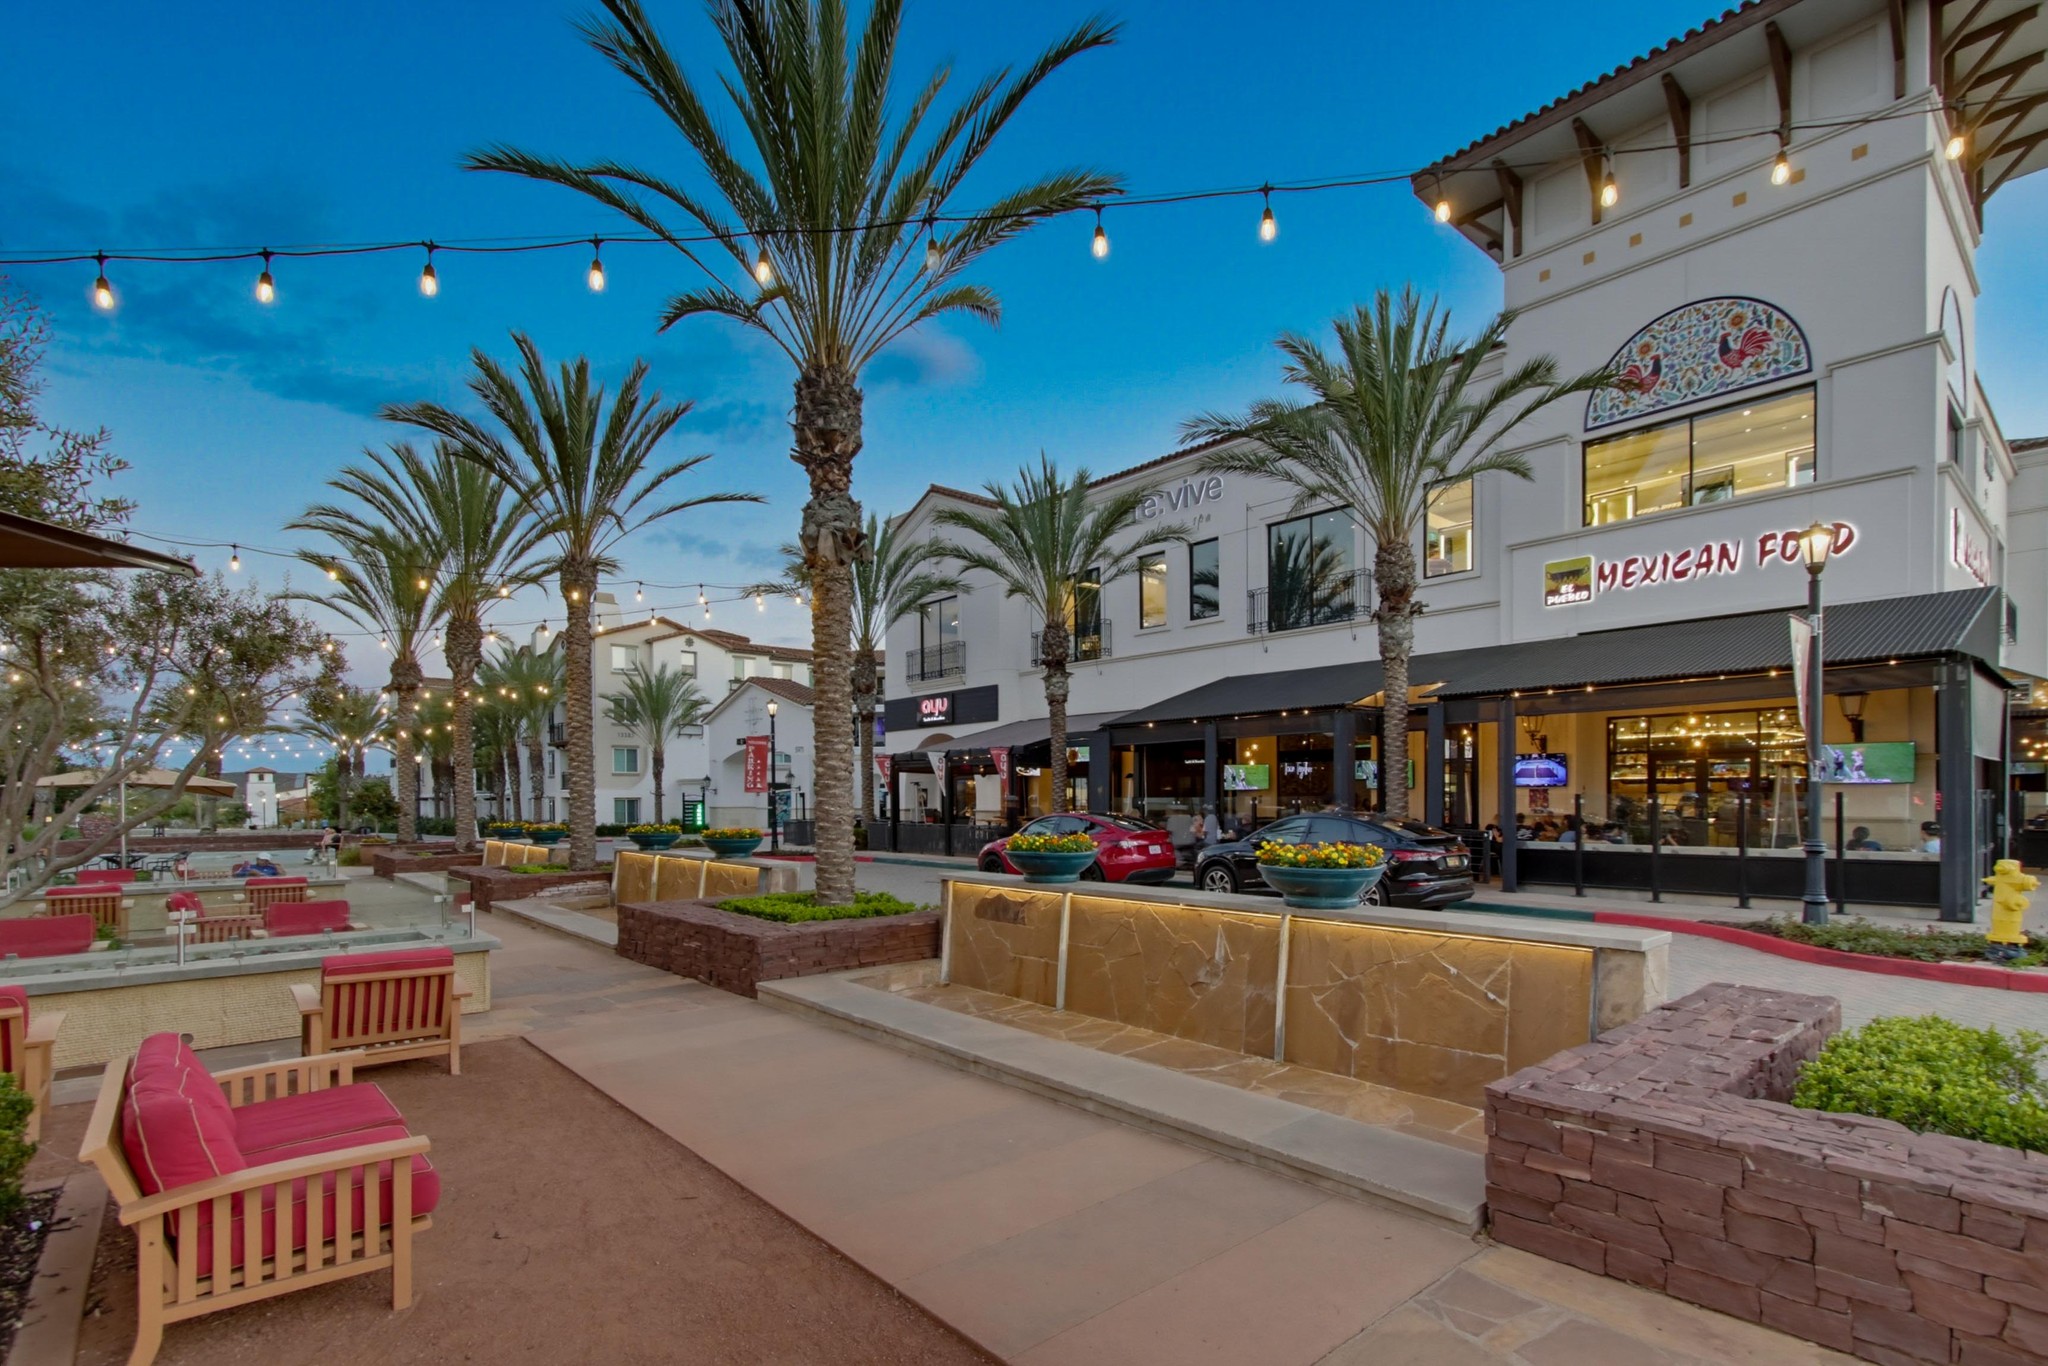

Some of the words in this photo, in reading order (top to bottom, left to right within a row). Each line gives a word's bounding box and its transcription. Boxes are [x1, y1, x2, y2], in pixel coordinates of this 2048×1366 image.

[1597, 540, 1742, 593] MEXICAN
[1758, 522, 1855, 567] FOD
[1546, 590, 1590, 606] PUEBLO
